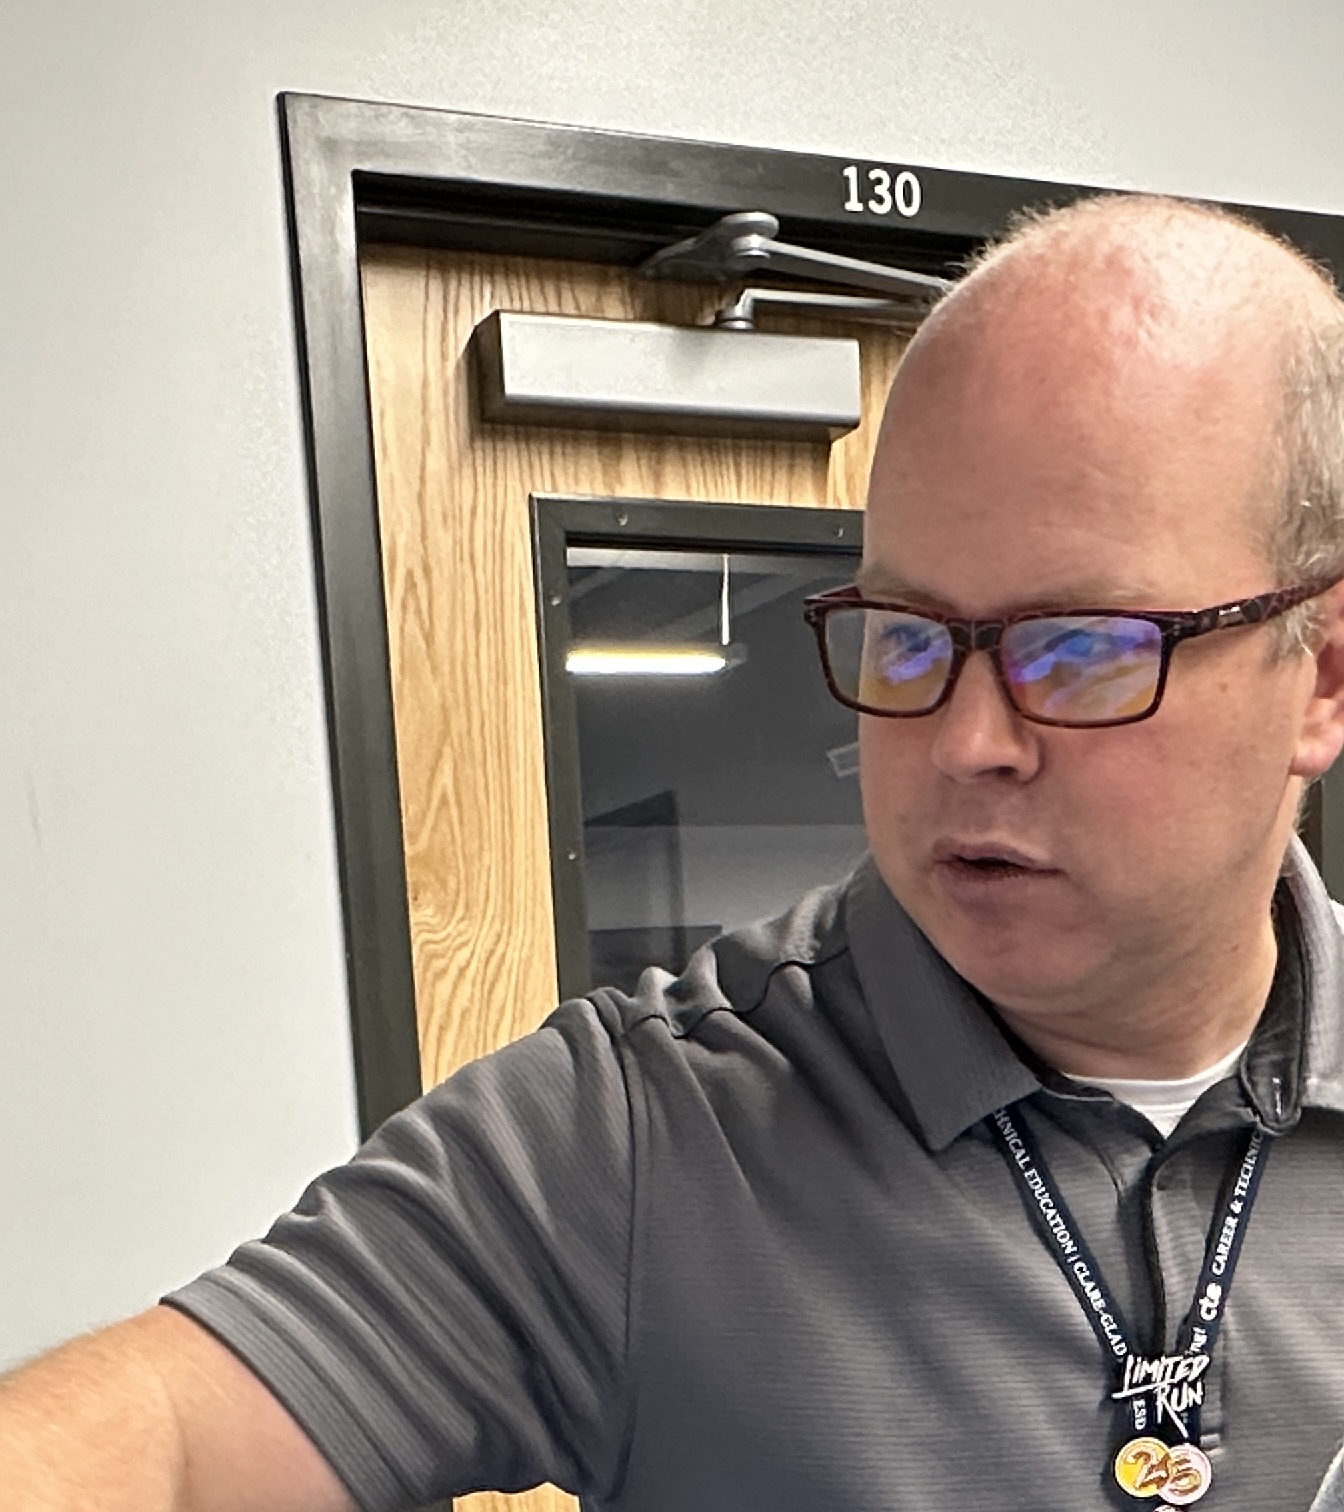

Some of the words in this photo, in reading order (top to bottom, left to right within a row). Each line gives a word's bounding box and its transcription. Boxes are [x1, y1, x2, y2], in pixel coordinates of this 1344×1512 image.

[842, 165, 922, 217] 130
[1024, 1168, 1077, 1254] EDUCATION
[1073, 1260, 1128, 1363] CLARE-GLAD
[1198, 1282, 1222, 1321] cte
[1212, 1216, 1239, 1276] CAREER
[1230, 1200, 1244, 1214] &
[1112, 1354, 1210, 1398] LIMITED
[1154, 1382, 1204, 1438] RUN
